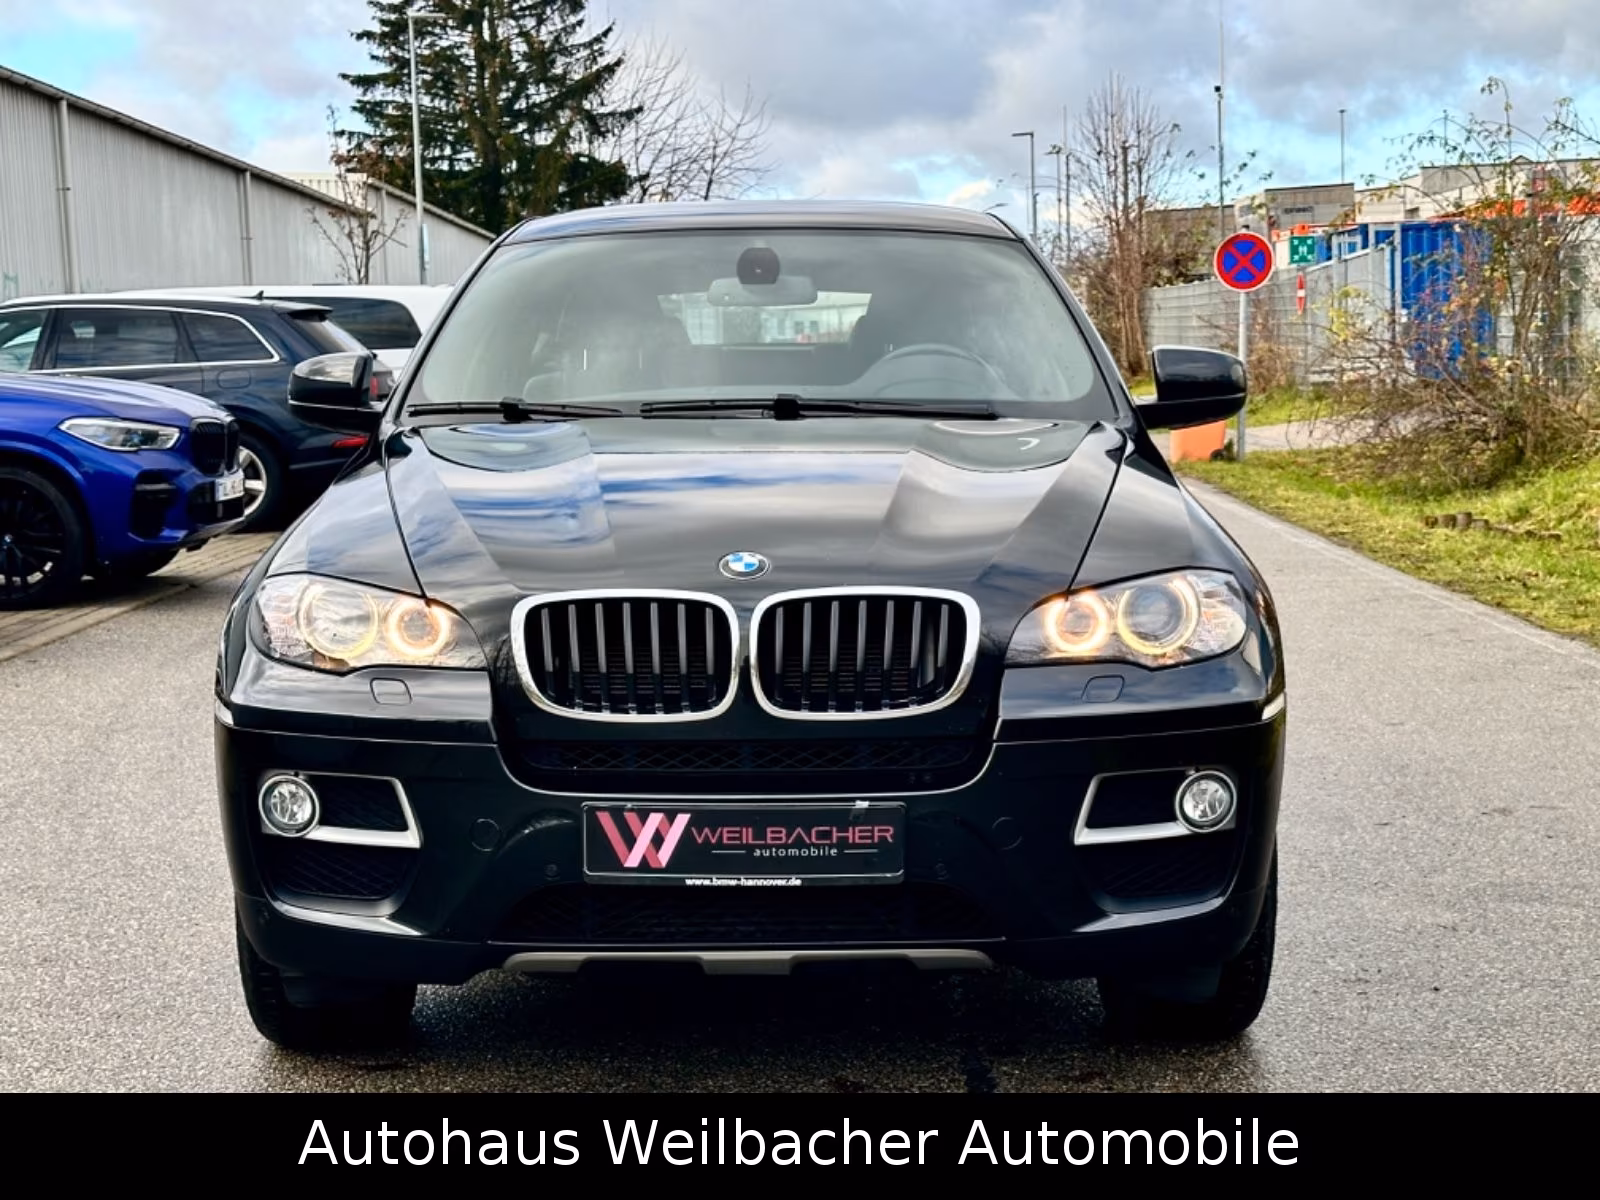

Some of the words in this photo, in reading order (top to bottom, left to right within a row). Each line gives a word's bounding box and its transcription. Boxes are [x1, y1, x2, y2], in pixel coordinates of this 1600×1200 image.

[691, 825, 895, 845] WEILBACHER
[753, 845, 839, 857] automobile
[685, 876, 803, 887] www.bmw-hannover.de
